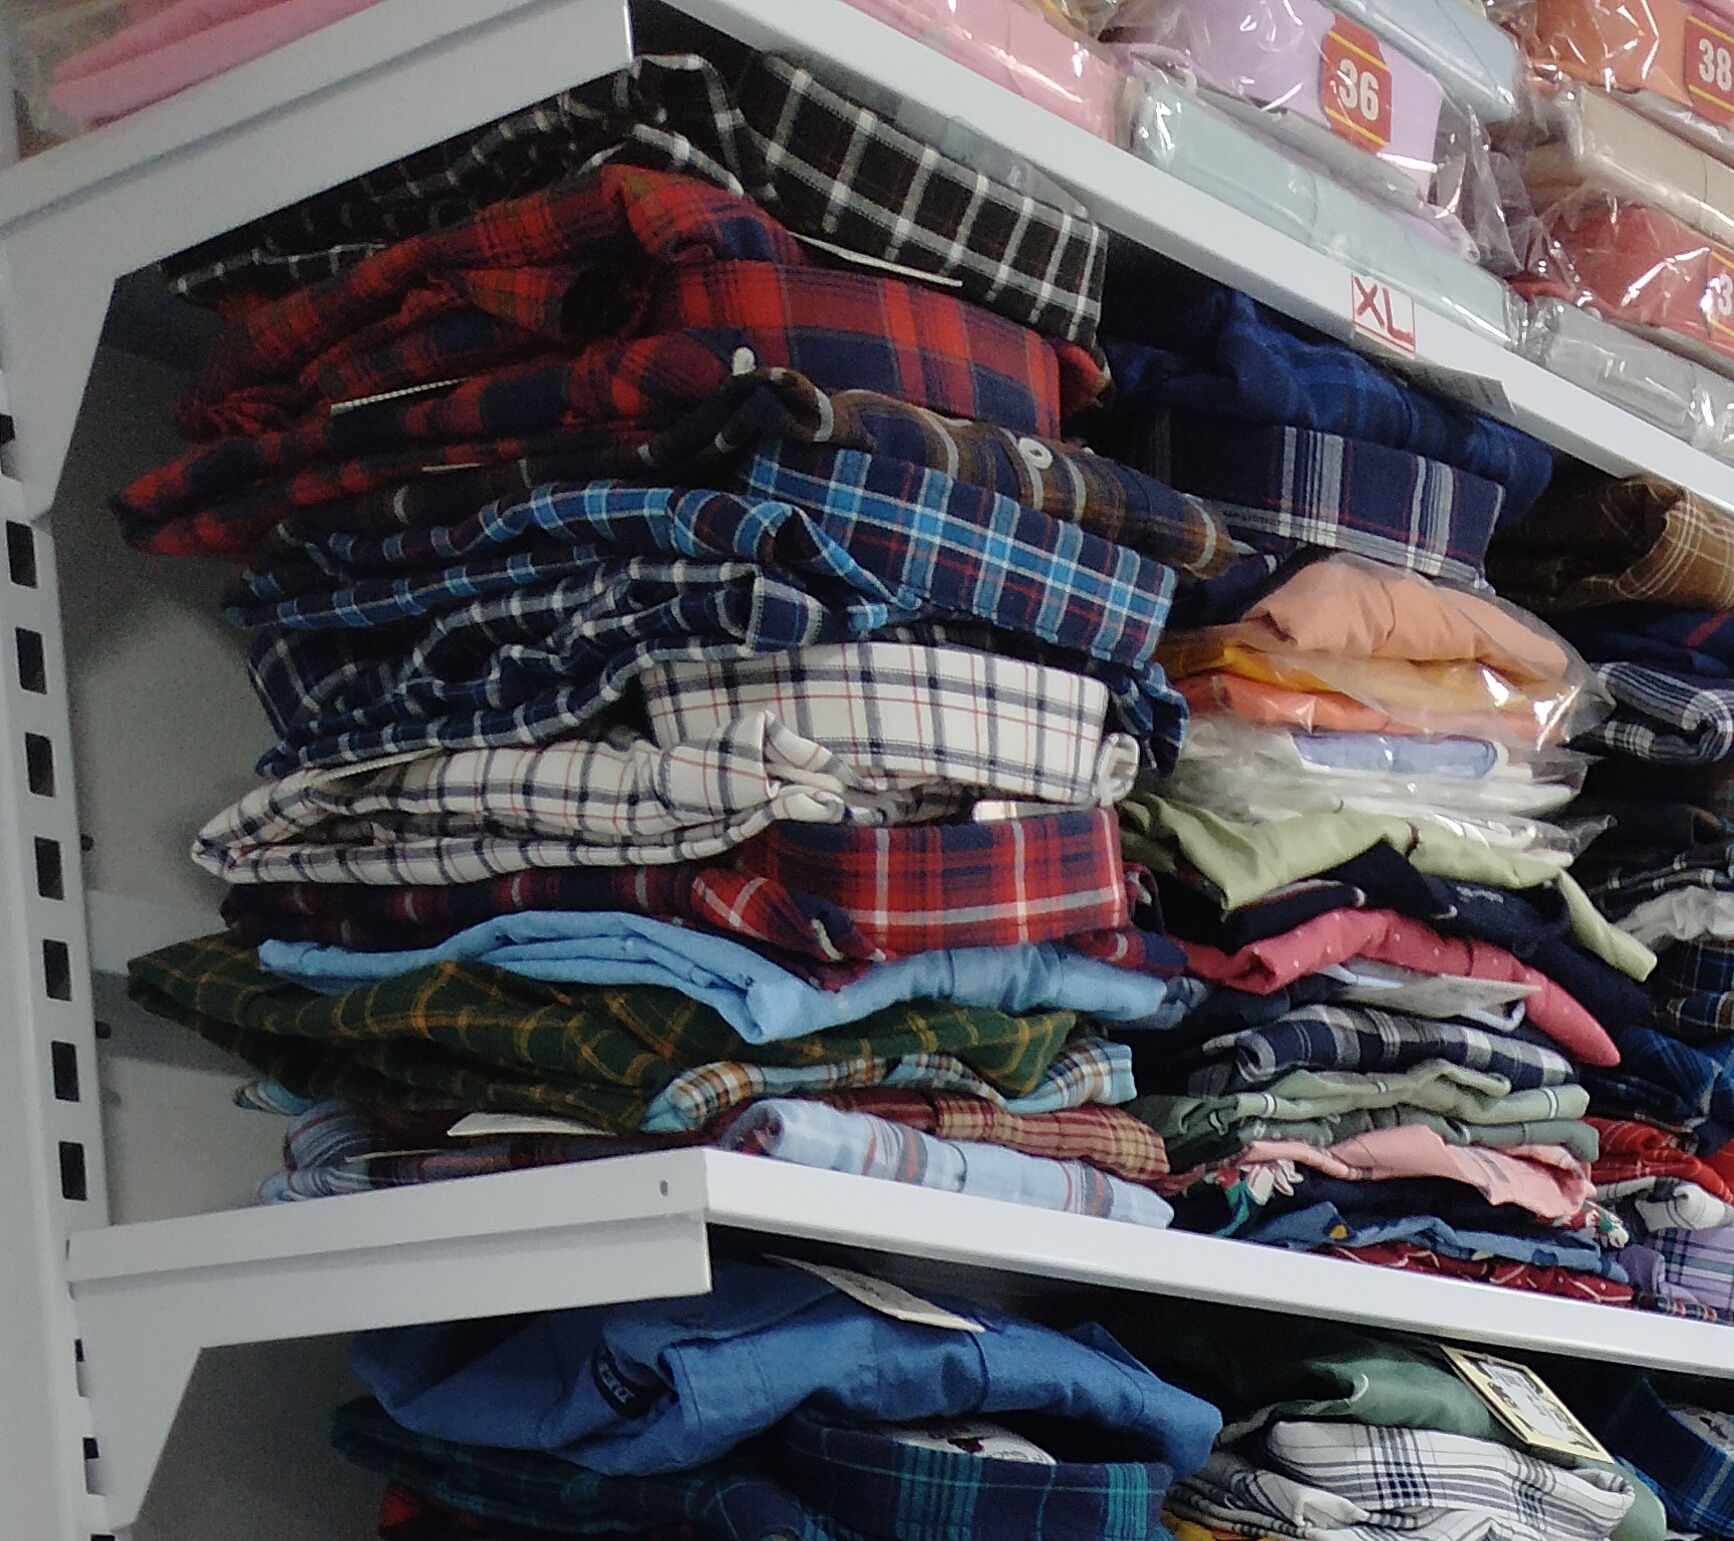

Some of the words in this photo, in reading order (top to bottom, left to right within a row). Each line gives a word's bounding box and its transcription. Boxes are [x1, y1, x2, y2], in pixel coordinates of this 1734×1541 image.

[1340, 59, 1379, 121] 36
[1699, 38, 1732, 91] 38
[1354, 276, 1415, 344] XL
